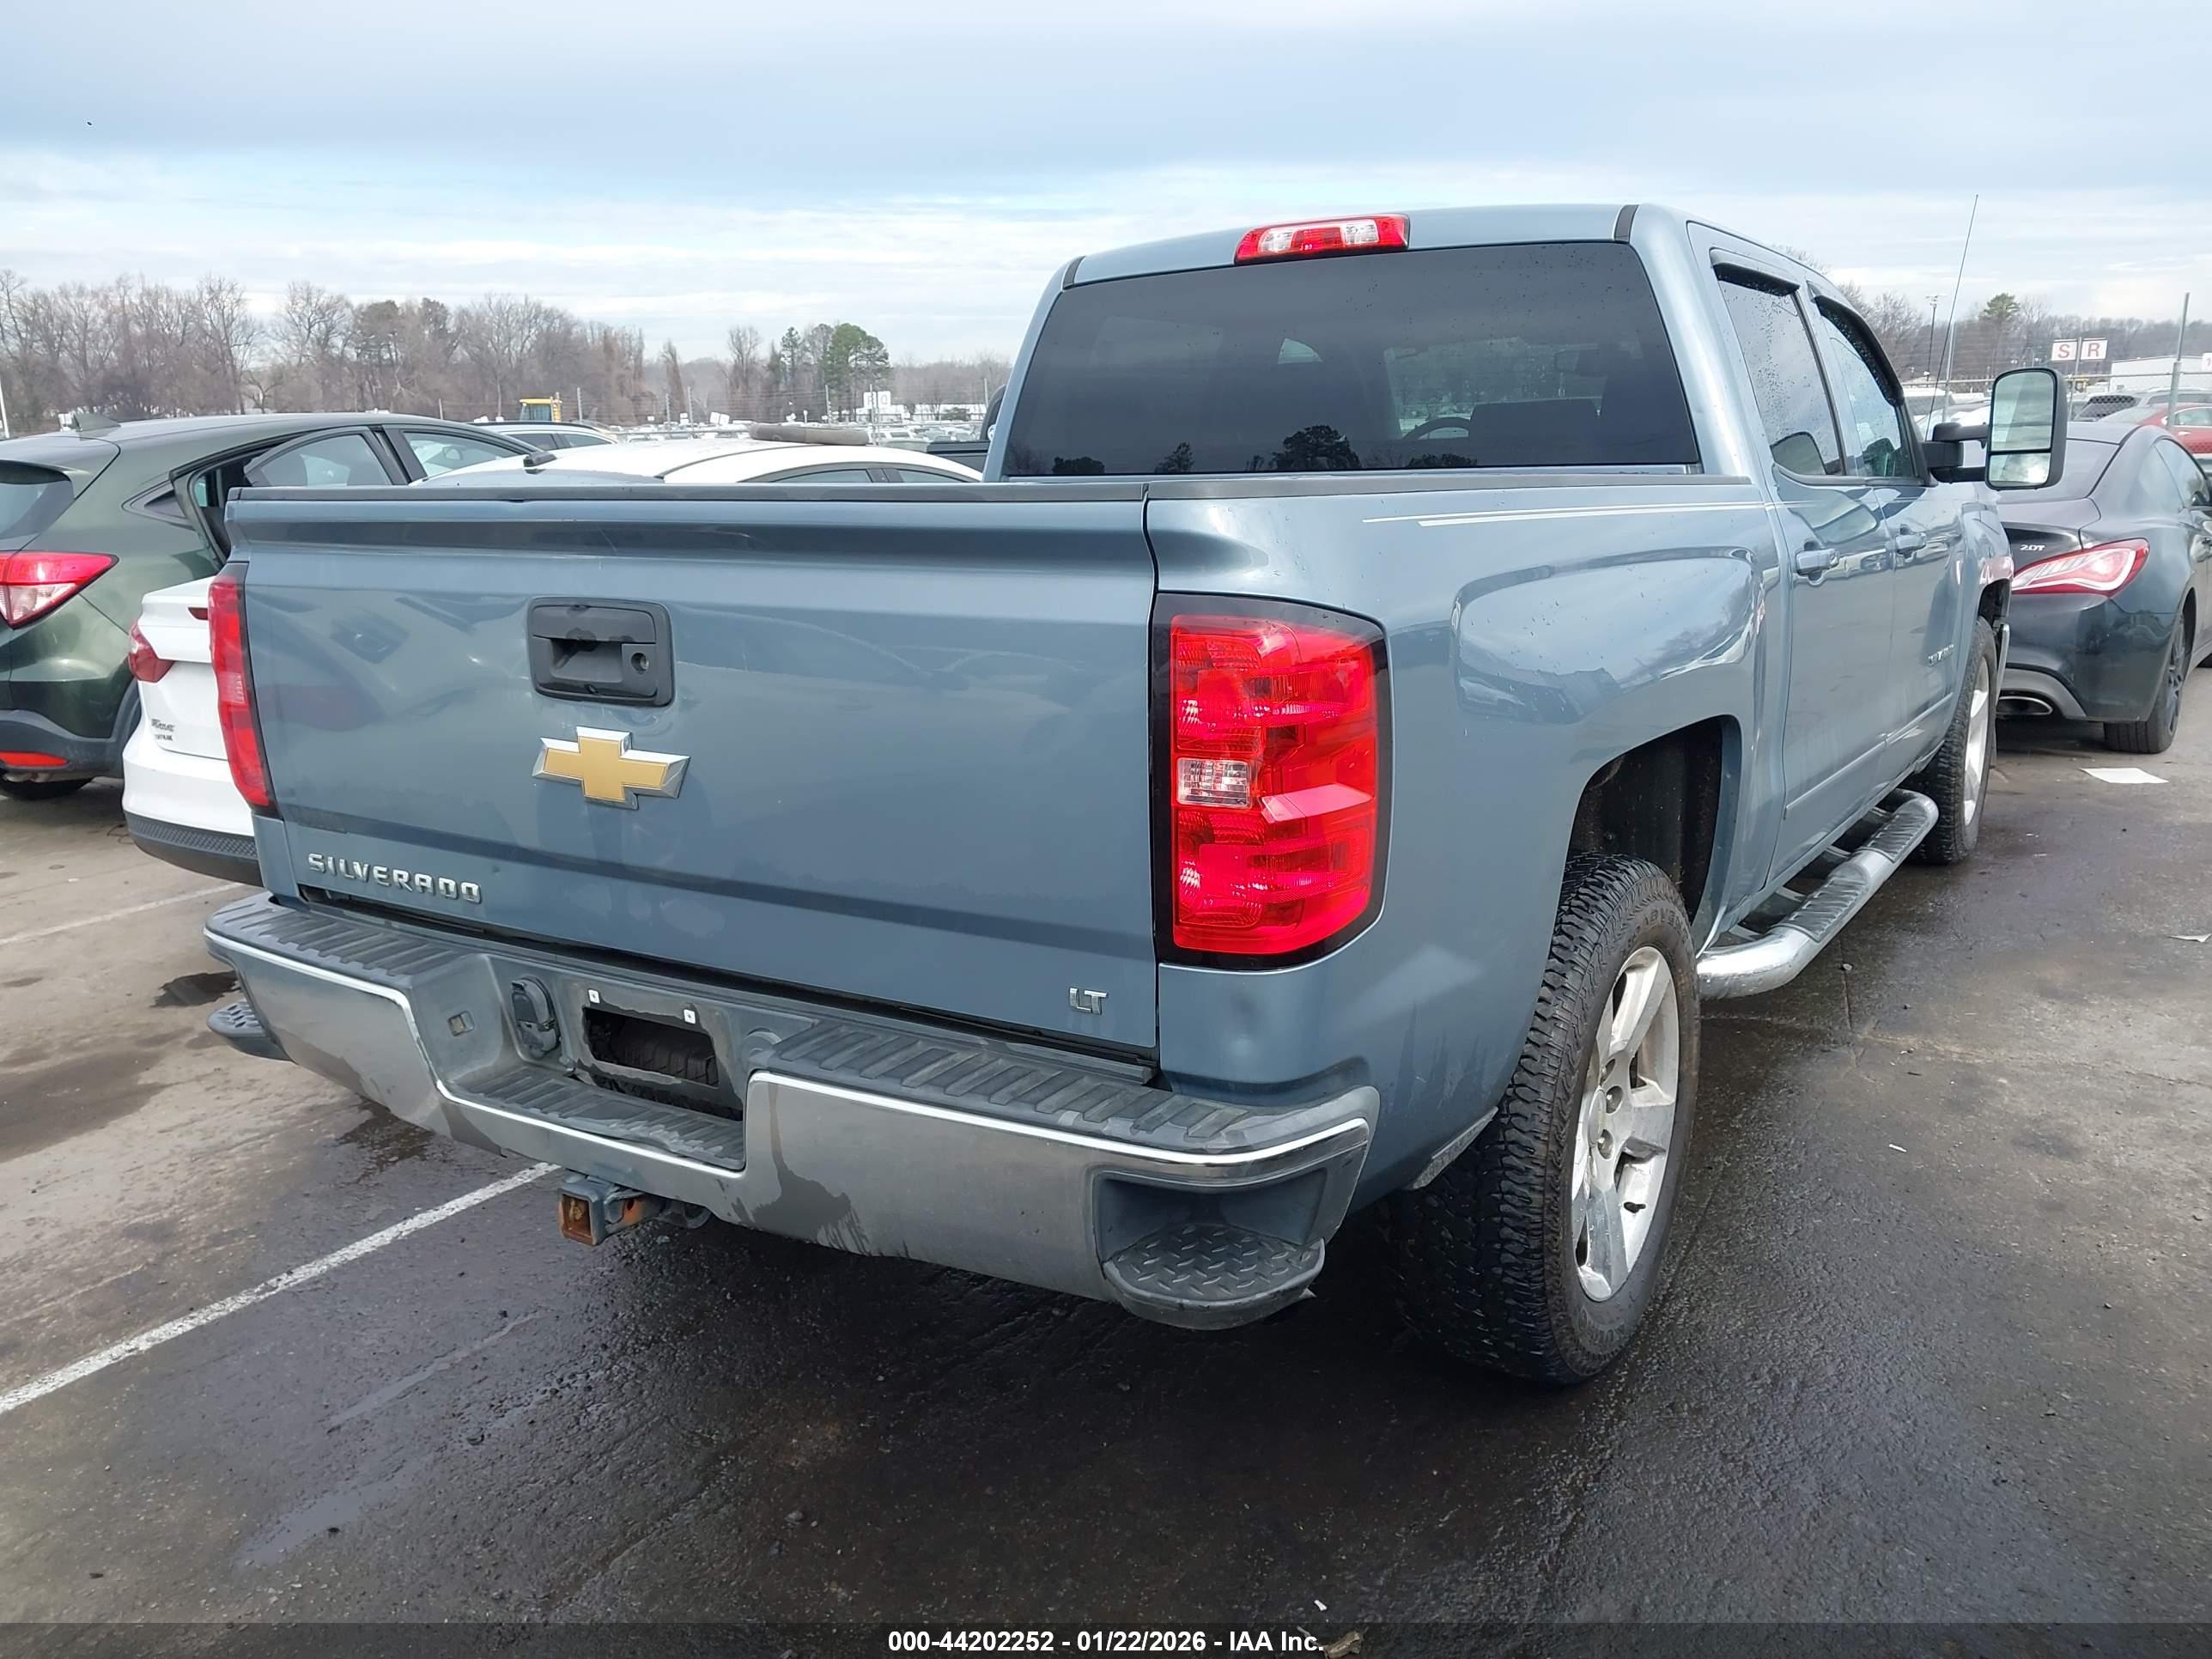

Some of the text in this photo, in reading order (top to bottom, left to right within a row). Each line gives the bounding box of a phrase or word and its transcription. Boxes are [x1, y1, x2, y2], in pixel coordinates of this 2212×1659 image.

[2057, 343, 2070, 358] S
[2087, 343, 2100, 357] R
[307, 852, 482, 904] SILVERADO
[1070, 987, 1108, 1015] LT
